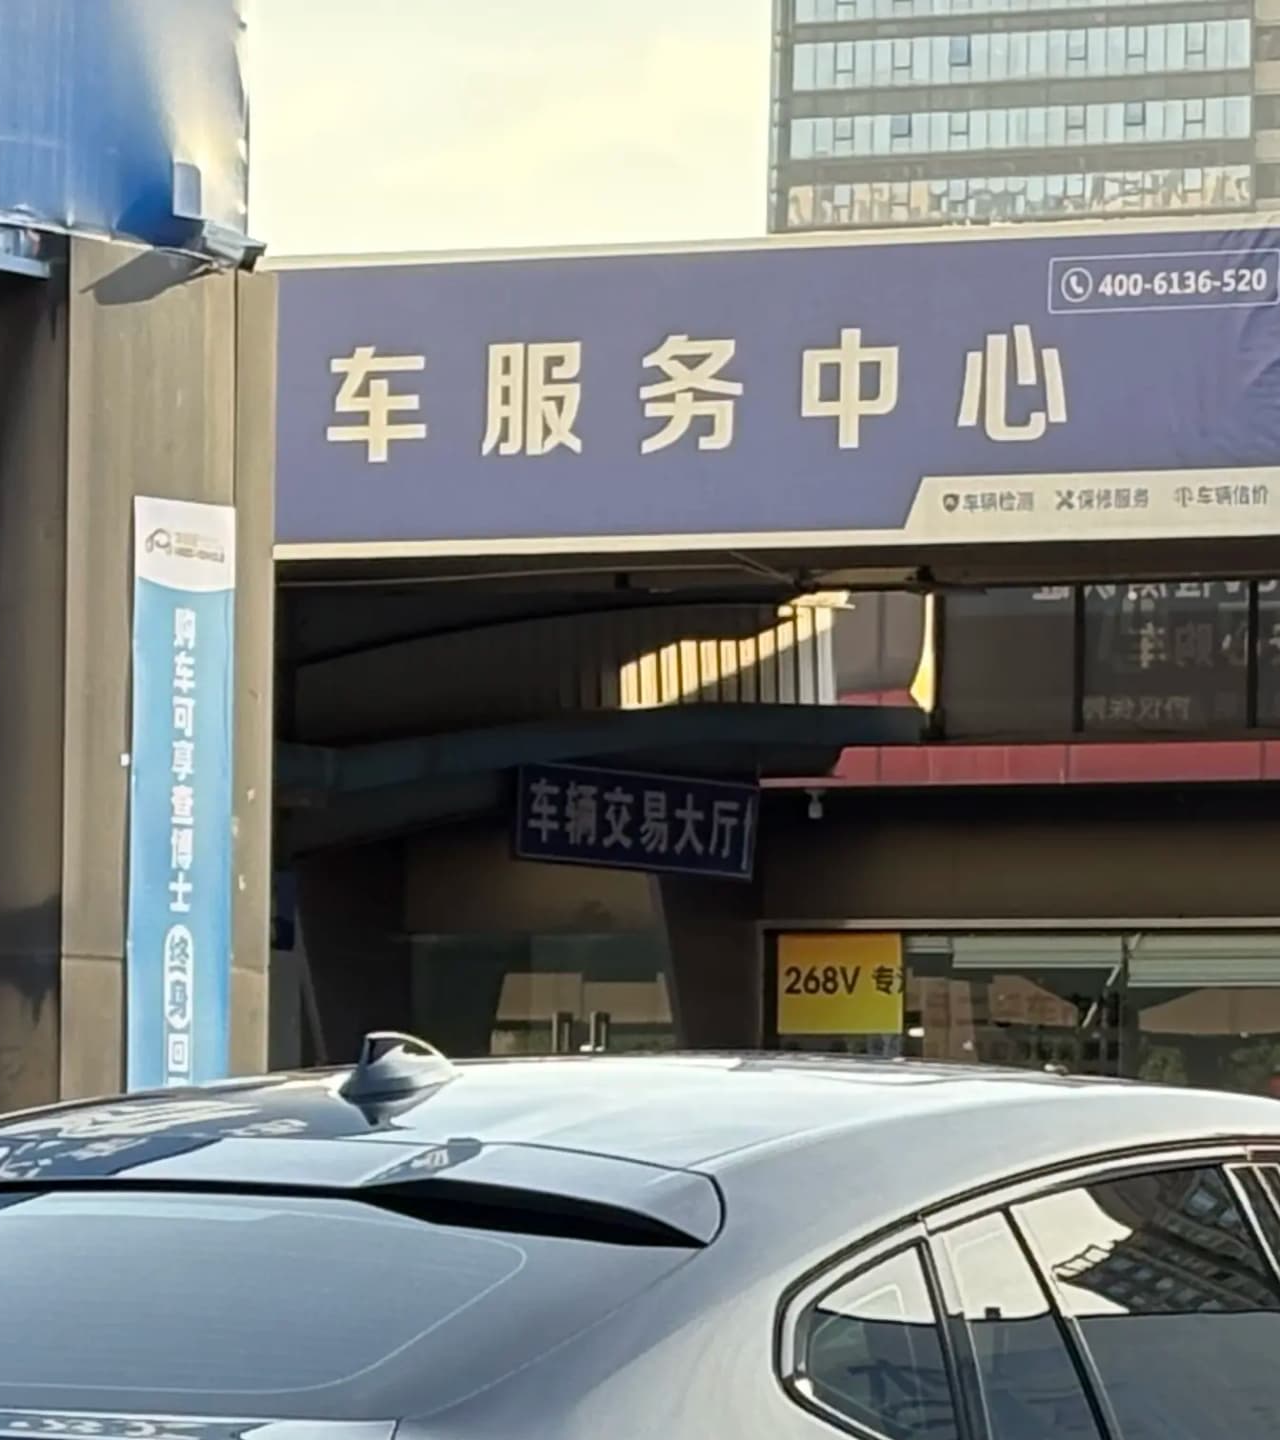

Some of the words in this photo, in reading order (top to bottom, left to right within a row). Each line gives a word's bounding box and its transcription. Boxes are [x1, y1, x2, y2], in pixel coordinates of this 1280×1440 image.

[1098, 268, 1267, 297] 400-6136-520
[325, 324, 1068, 463] 车服务中心
[1078, 487, 1150, 511] 保修服务
[168, 607, 197, 913] 购车可享查博士
[527, 777, 740, 859] 车辆交易大厅
[167, 935, 191, 1086] 终身回
[785, 966, 861, 995] 268V
